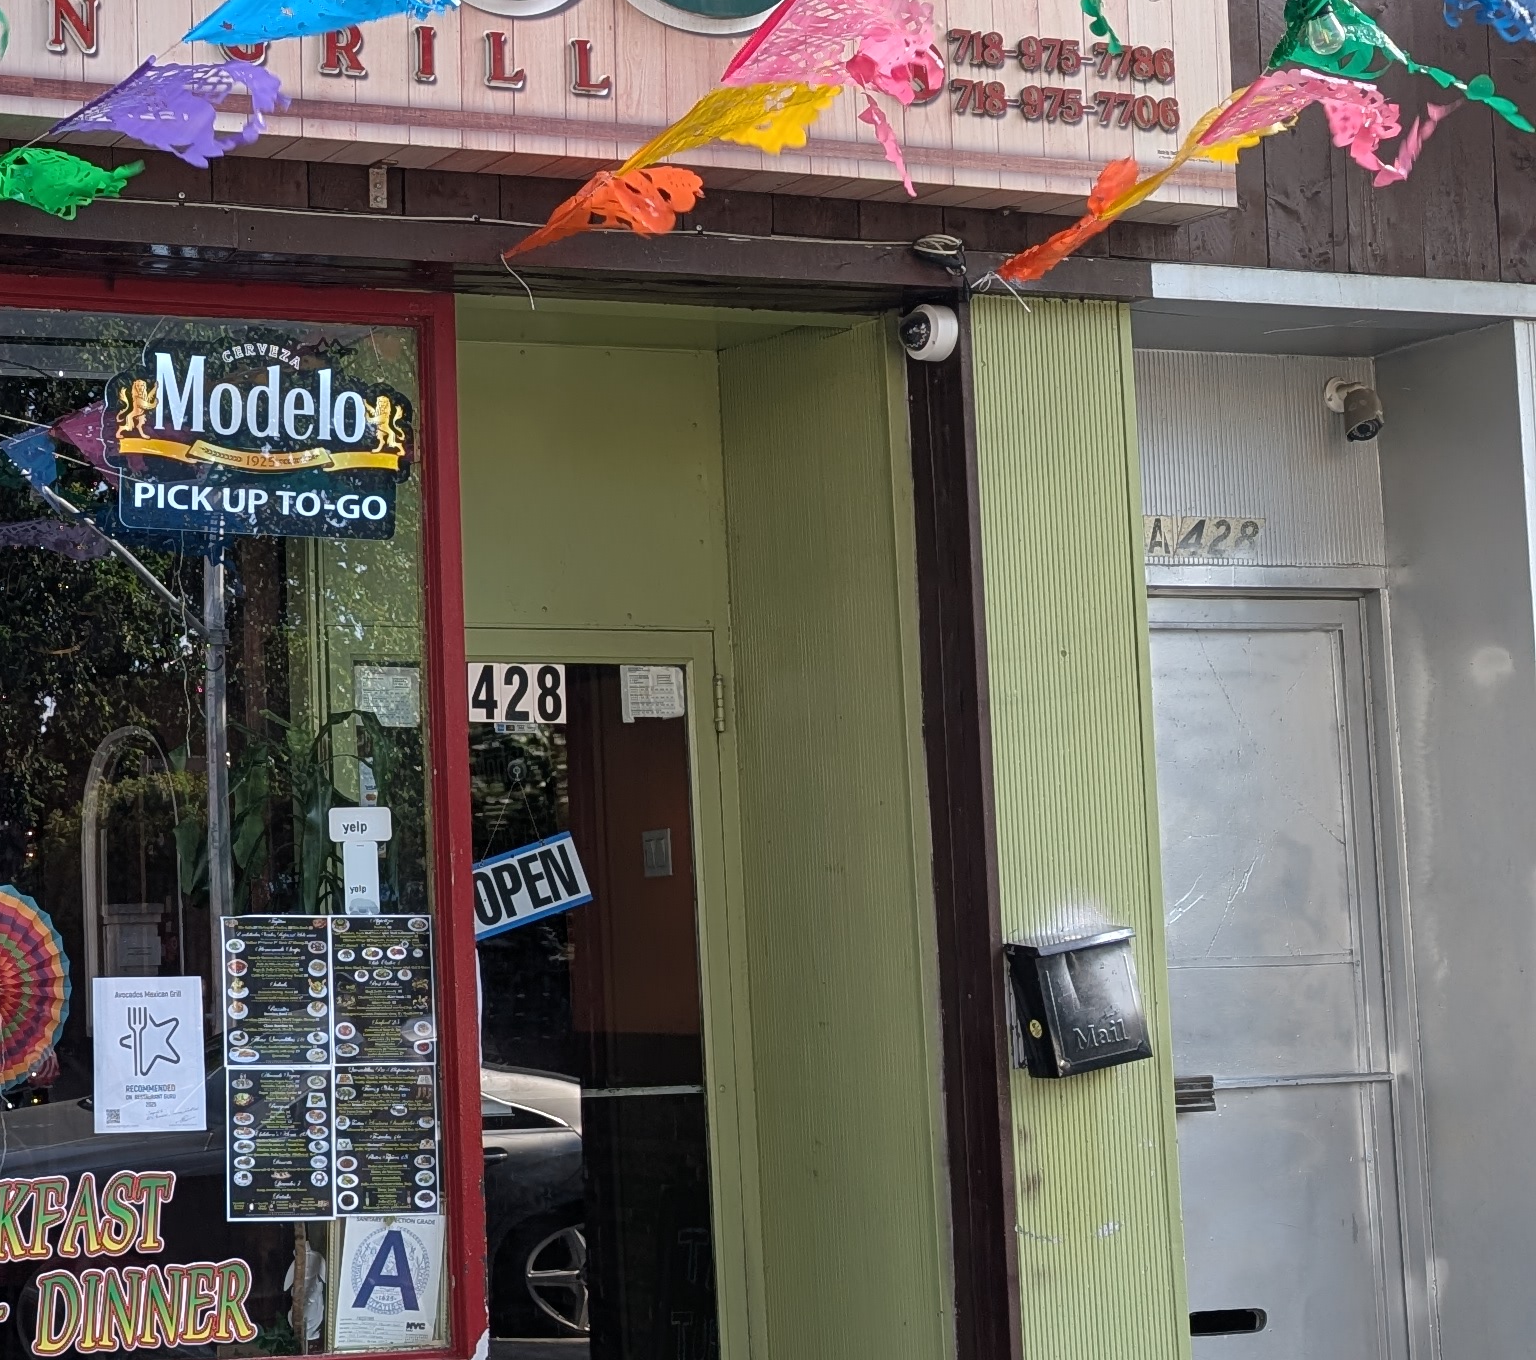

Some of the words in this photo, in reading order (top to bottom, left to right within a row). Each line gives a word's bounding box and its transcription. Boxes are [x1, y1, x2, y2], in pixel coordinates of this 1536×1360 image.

[219, 22, 612, 96] RILL
[948, 28, 1175, 83] 718-975-7786
[950, 78, 1181, 132] 718-975-7706
[221, 342, 301, 371] CERVEZA
[154, 351, 366, 443] Modelo
[245, 455, 275, 468] 1925
[134, 482, 213, 512] PICK
[222, 487, 268, 515] UP
[276, 490, 388, 520] TO-GO
[471, 664, 563, 722] 428
[342, 820, 368, 834] yelp
[474, 843, 582, 927] OPEN
[1073, 1018, 1129, 1051] Mail
[125, 1084, 176, 1093] RECOMMENDED
[351, 1229, 420, 1311] A
[32, 1257, 258, 1358] DINNER
[406, 1321, 425, 1330] NYC
